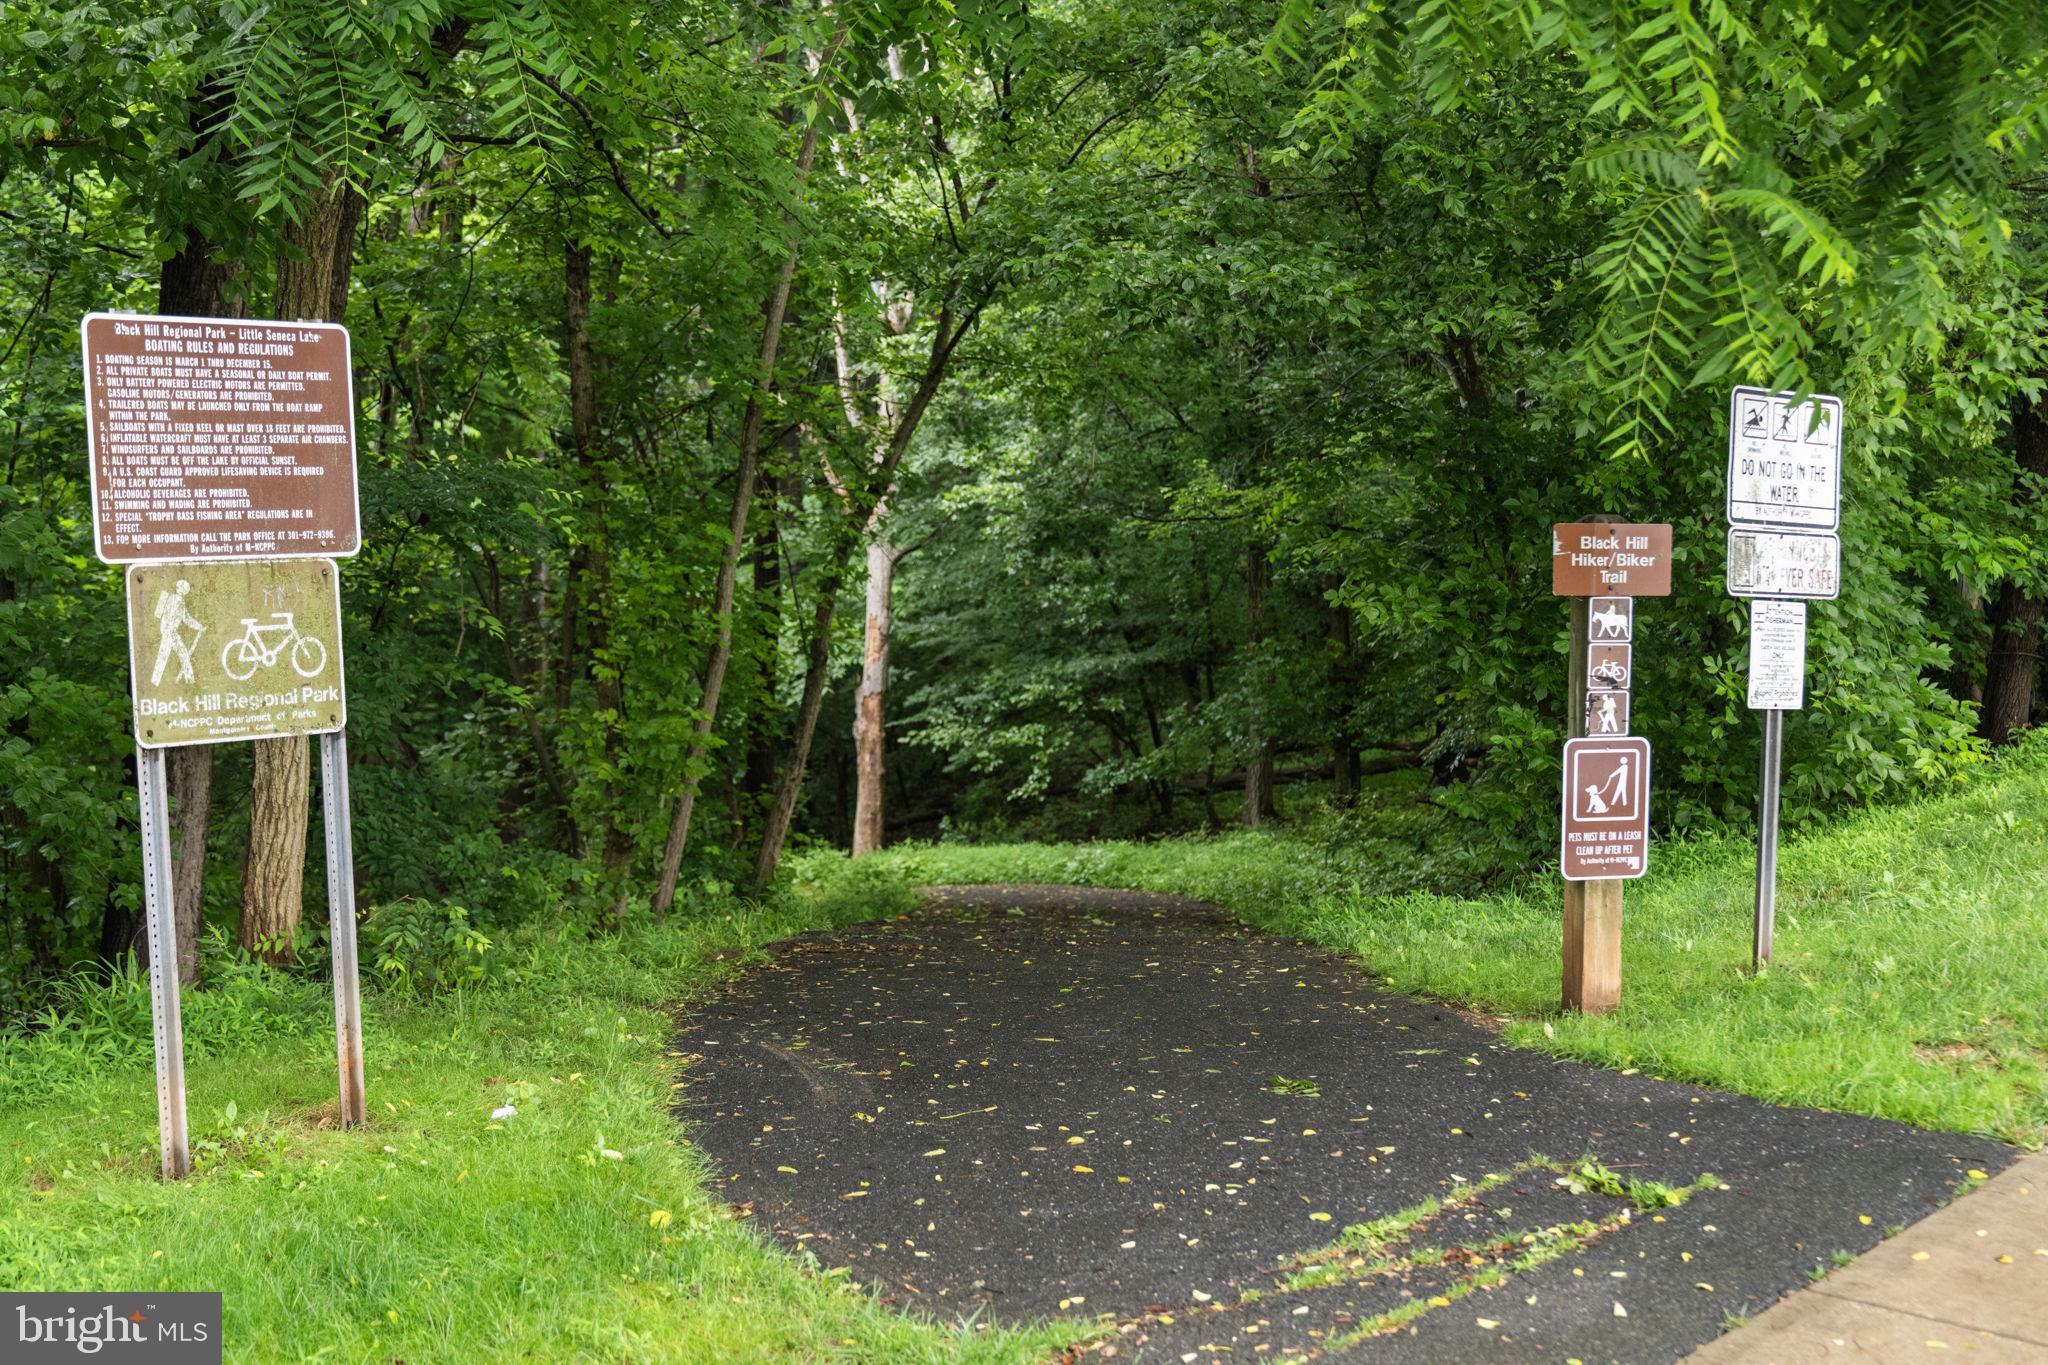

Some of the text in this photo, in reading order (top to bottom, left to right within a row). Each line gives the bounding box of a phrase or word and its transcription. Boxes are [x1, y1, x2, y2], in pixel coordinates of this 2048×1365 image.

[143, 323, 159, 336] Hill
[162, 324, 201, 338] Regional
[205, 326, 225, 338] Park
[238, 327, 262, 340] Little
[265, 329, 296, 341] Seneca
[144, 339, 293, 356] BOATING RULES AND REGULATIONS
[104, 354, 133, 364] BOATING
[136, 355, 163, 365] SEASON
[165, 356, 172, 365] IS
[174, 356, 198, 366] MARCH
[201, 358, 204, 366] 1
[207, 357, 224, 367] THRU
[226, 358, 260, 368] DECEMBER
[105, 365, 118, 375] ALL
[120, 366, 148, 375] PRIVATE
[150, 367, 172, 376] BOATS
[174, 367, 192, 377] MUST
[195, 368, 211, 377] HAVE
[214, 368, 219, 377] A
[221, 369, 254, 378] SEASONAL
[256, 370, 265, 379] OR
[268, 370, 285, 379] DAILY
[287, 370, 304, 380] BOAT
[106, 376, 123, 386] ONLY
[125, 377, 154, 387] BATTERY
[157, 378, 189, 387] POWERED
[191, 379, 222, 388] ELECTRIC
[224, 380, 250, 389] MOTORS
[253, 381, 265, 389] ARE
[107, 388, 139, 397] GASOLINE
[219, 390, 232, 399] ARE
[108, 399, 144, 409] TRAILERED
[147, 400, 168, 409] BOATS
[170, 400, 184, 409] MAY
[186, 401, 195, 410] BE
[197, 401, 231, 410] LAUNCHED
[233, 401, 249, 411] ONLY
[251, 402, 270, 411] FROM
[271, 402, 284, 412] THE
[286, 402, 302, 412] BOAT
[304, 403, 323, 412] RAMP
[108, 410, 132, 419] WITHIN
[135, 411, 147, 420] THE
[110, 444, 158, 453] WINDSURFERS
[160, 445, 174, 453] AND
[177, 445, 217, 454] SAILBOARDS
[220, 445, 232, 454] ARE
[112, 466, 117, 476] A
[135, 466, 157, 476] COAST
[159, 467, 182, 476] GUARD
[184, 466, 218, 476] APPROVED
[221, 466, 257, 476] LIFESAVING
[259, 466, 282, 475] DEVICE
[284, 466, 291, 475] IS
[292, 466, 324, 476] REQUIRED
[1742, 459, 1826, 482] DO NOT GO IN THE
[112, 478, 125, 487] FOR
[128, 478, 146, 487] EACH
[113, 489, 150, 498] ALCOHOLIC
[153, 488, 191, 498] BEVERAGES
[193, 488, 206, 497] ARE
[1770, 485, 1800, 502] WATER
[114, 500, 149, 509] SWIMMING
[152, 500, 166, 509] AND
[168, 499, 194, 508] WADING
[197, 499, 209, 508] ARE
[114, 511, 142, 521] SPECIAL
[176, 511, 194, 520] BASS
[196, 510, 222, 520] FISHING
[247, 509, 289, 519] REGULATIONS
[291, 508, 303, 518] ARE
[305, 508, 313, 518] IN
[131, 533, 151, 544] MORE
[153, 532, 198, 543] INFORMATION
[200, 532, 217, 542] CALL
[218, 532, 231, 541] THE
[233, 531, 250, 540] PARK
[253, 531, 275, 540] OFFICE
[277, 530, 285, 540] AT
[1580, 536, 1648, 550] Black Hill
[189, 543, 198, 554] By
[201, 543, 233, 553] Authority
[235, 543, 242, 551] of
[1571, 552, 1656, 568] Hiker/Biker
[1600, 570, 1627, 584] Trail
[140, 686, 339, 716] Black Hill Regional Park
[217, 712, 271, 726] Department
[292, 710, 317, 720] Parks
[1568, 830, 1642, 842] PETS MUST BE ON A LEASH
[1576, 844, 1633, 856] CLEAN UP AFTER PET
